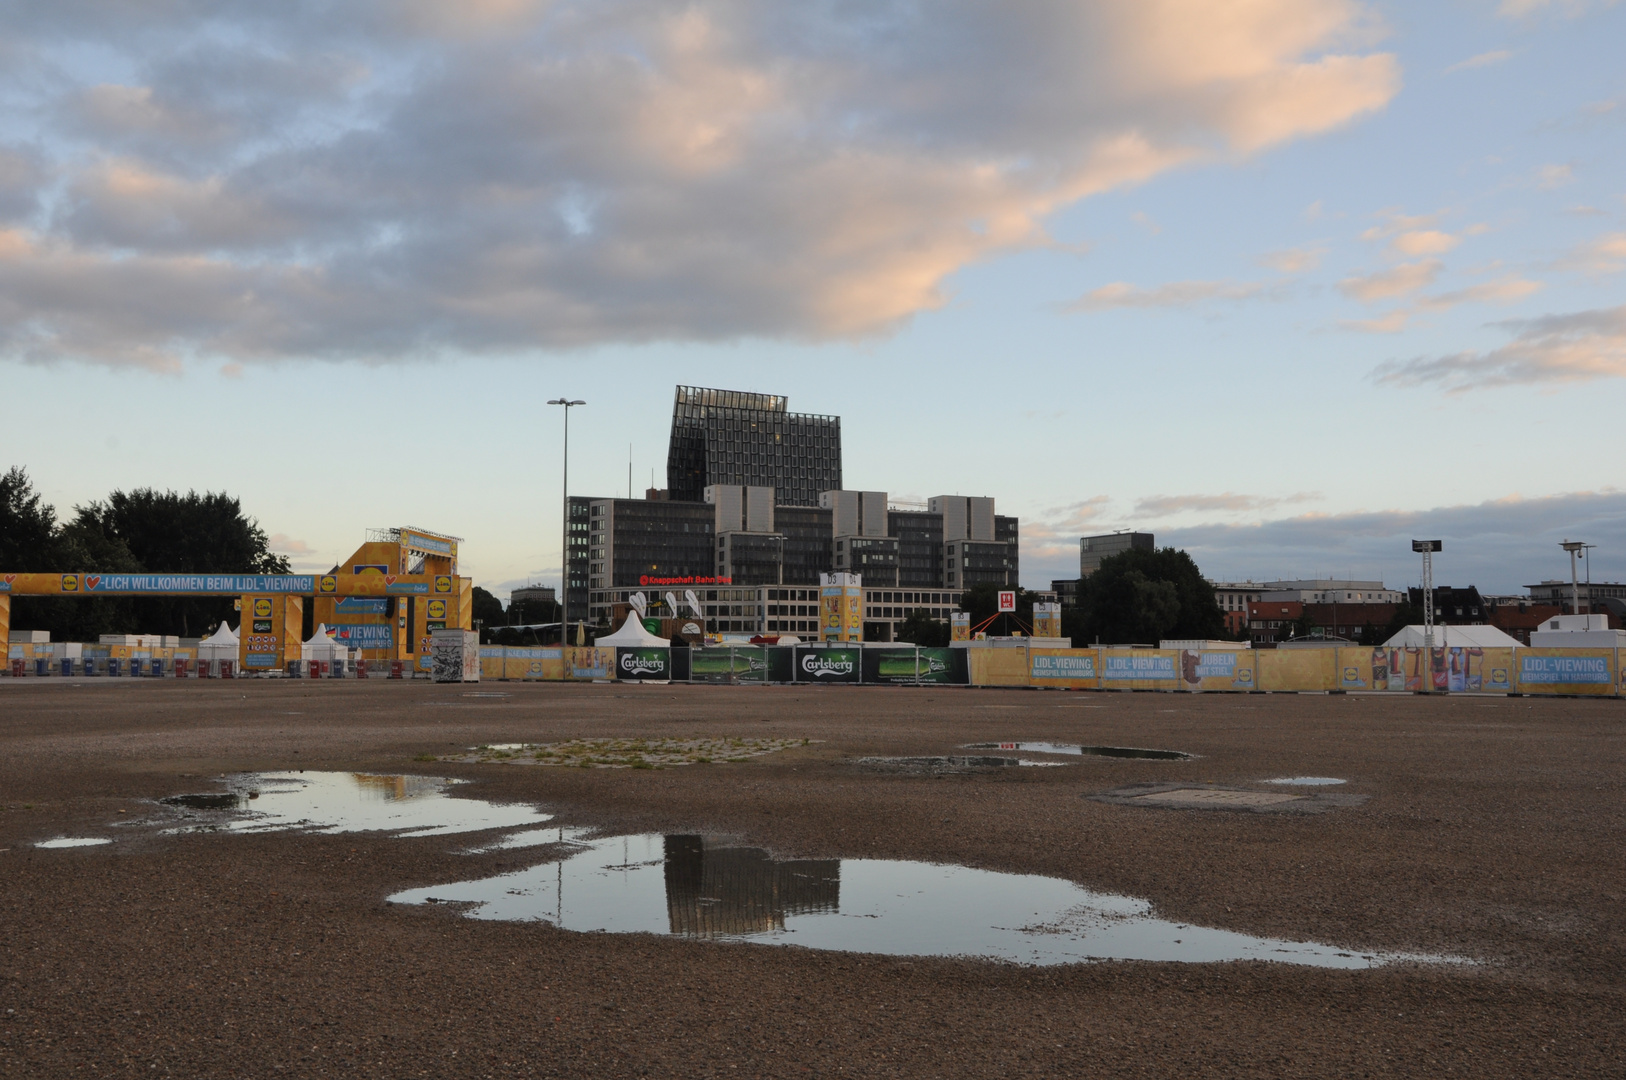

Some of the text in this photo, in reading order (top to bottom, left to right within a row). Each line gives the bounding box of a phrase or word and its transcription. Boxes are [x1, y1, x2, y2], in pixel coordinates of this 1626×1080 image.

[132, 577, 204, 590] WILLKOMMEN
[207, 578, 233, 590] BEIM
[236, 577, 312, 591] LIDL-VIEWING!
[649, 576, 733, 585] Knappschaft Bahn See
[828, 575, 836, 584] D3
[621, 654, 664, 675] Carlsberg
[1035, 658, 1091, 669] LIDL-VIEWING
[1108, 659, 1170, 670] LIDL-VIEWING
[1203, 654, 1234, 665] JUBELN
[802, 655, 853, 677] Carlsberg
[1197, 666, 1209, 675] MIT
[1524, 659, 1604, 672] LIDL-VIEWING
[1106, 670, 1136, 678] HEIMSPIEL
[1522, 672, 1560, 680] HEIMSPIEL
